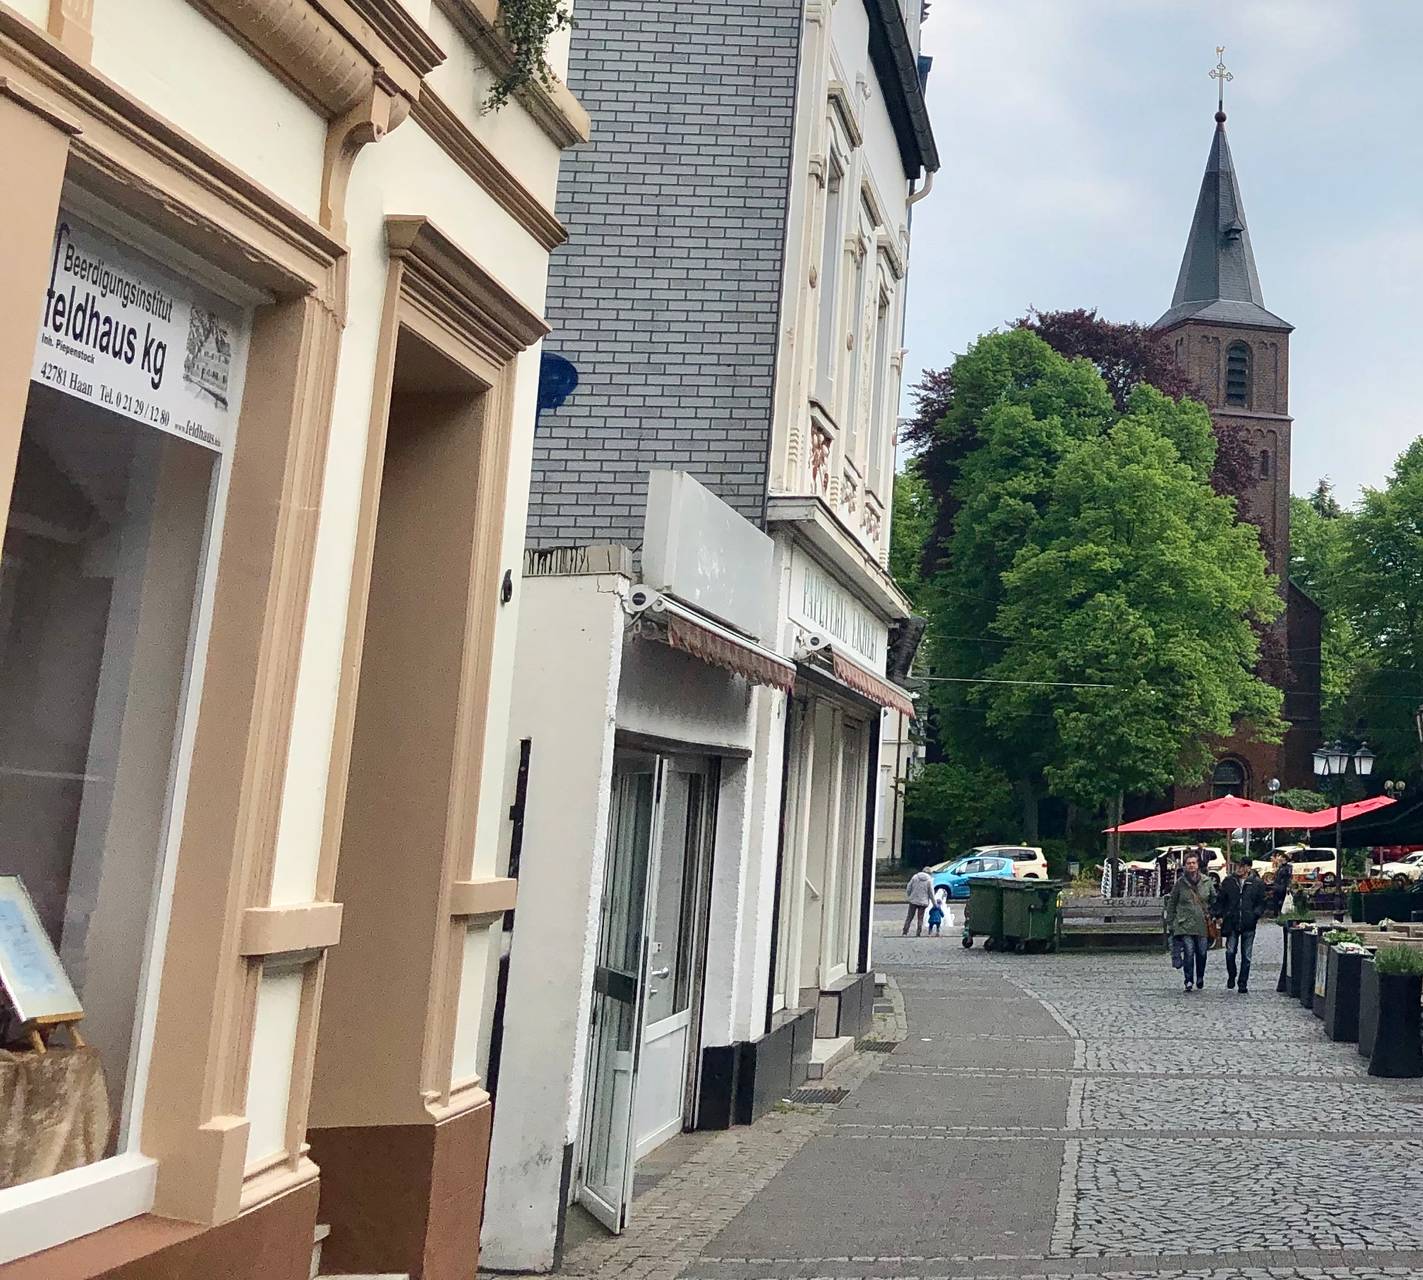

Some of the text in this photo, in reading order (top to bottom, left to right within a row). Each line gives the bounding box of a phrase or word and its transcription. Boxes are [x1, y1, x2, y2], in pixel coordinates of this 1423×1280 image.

[43, 222, 167, 390] feldhaus kg
[64, 243, 173, 323] Beerdigungsinstitut
[56, 339, 96, 365] Piepenstock
[40, 362, 67, 387] 42781
[69, 372, 93, 397] Haan
[100, 384, 114, 405] Tel.
[116, 392, 122, 408] 0
[122, 394, 132, 412] 21
[134, 398, 144, 416] 29
[150, 405, 159, 422] 12
[160, 409, 170, 427] 80
